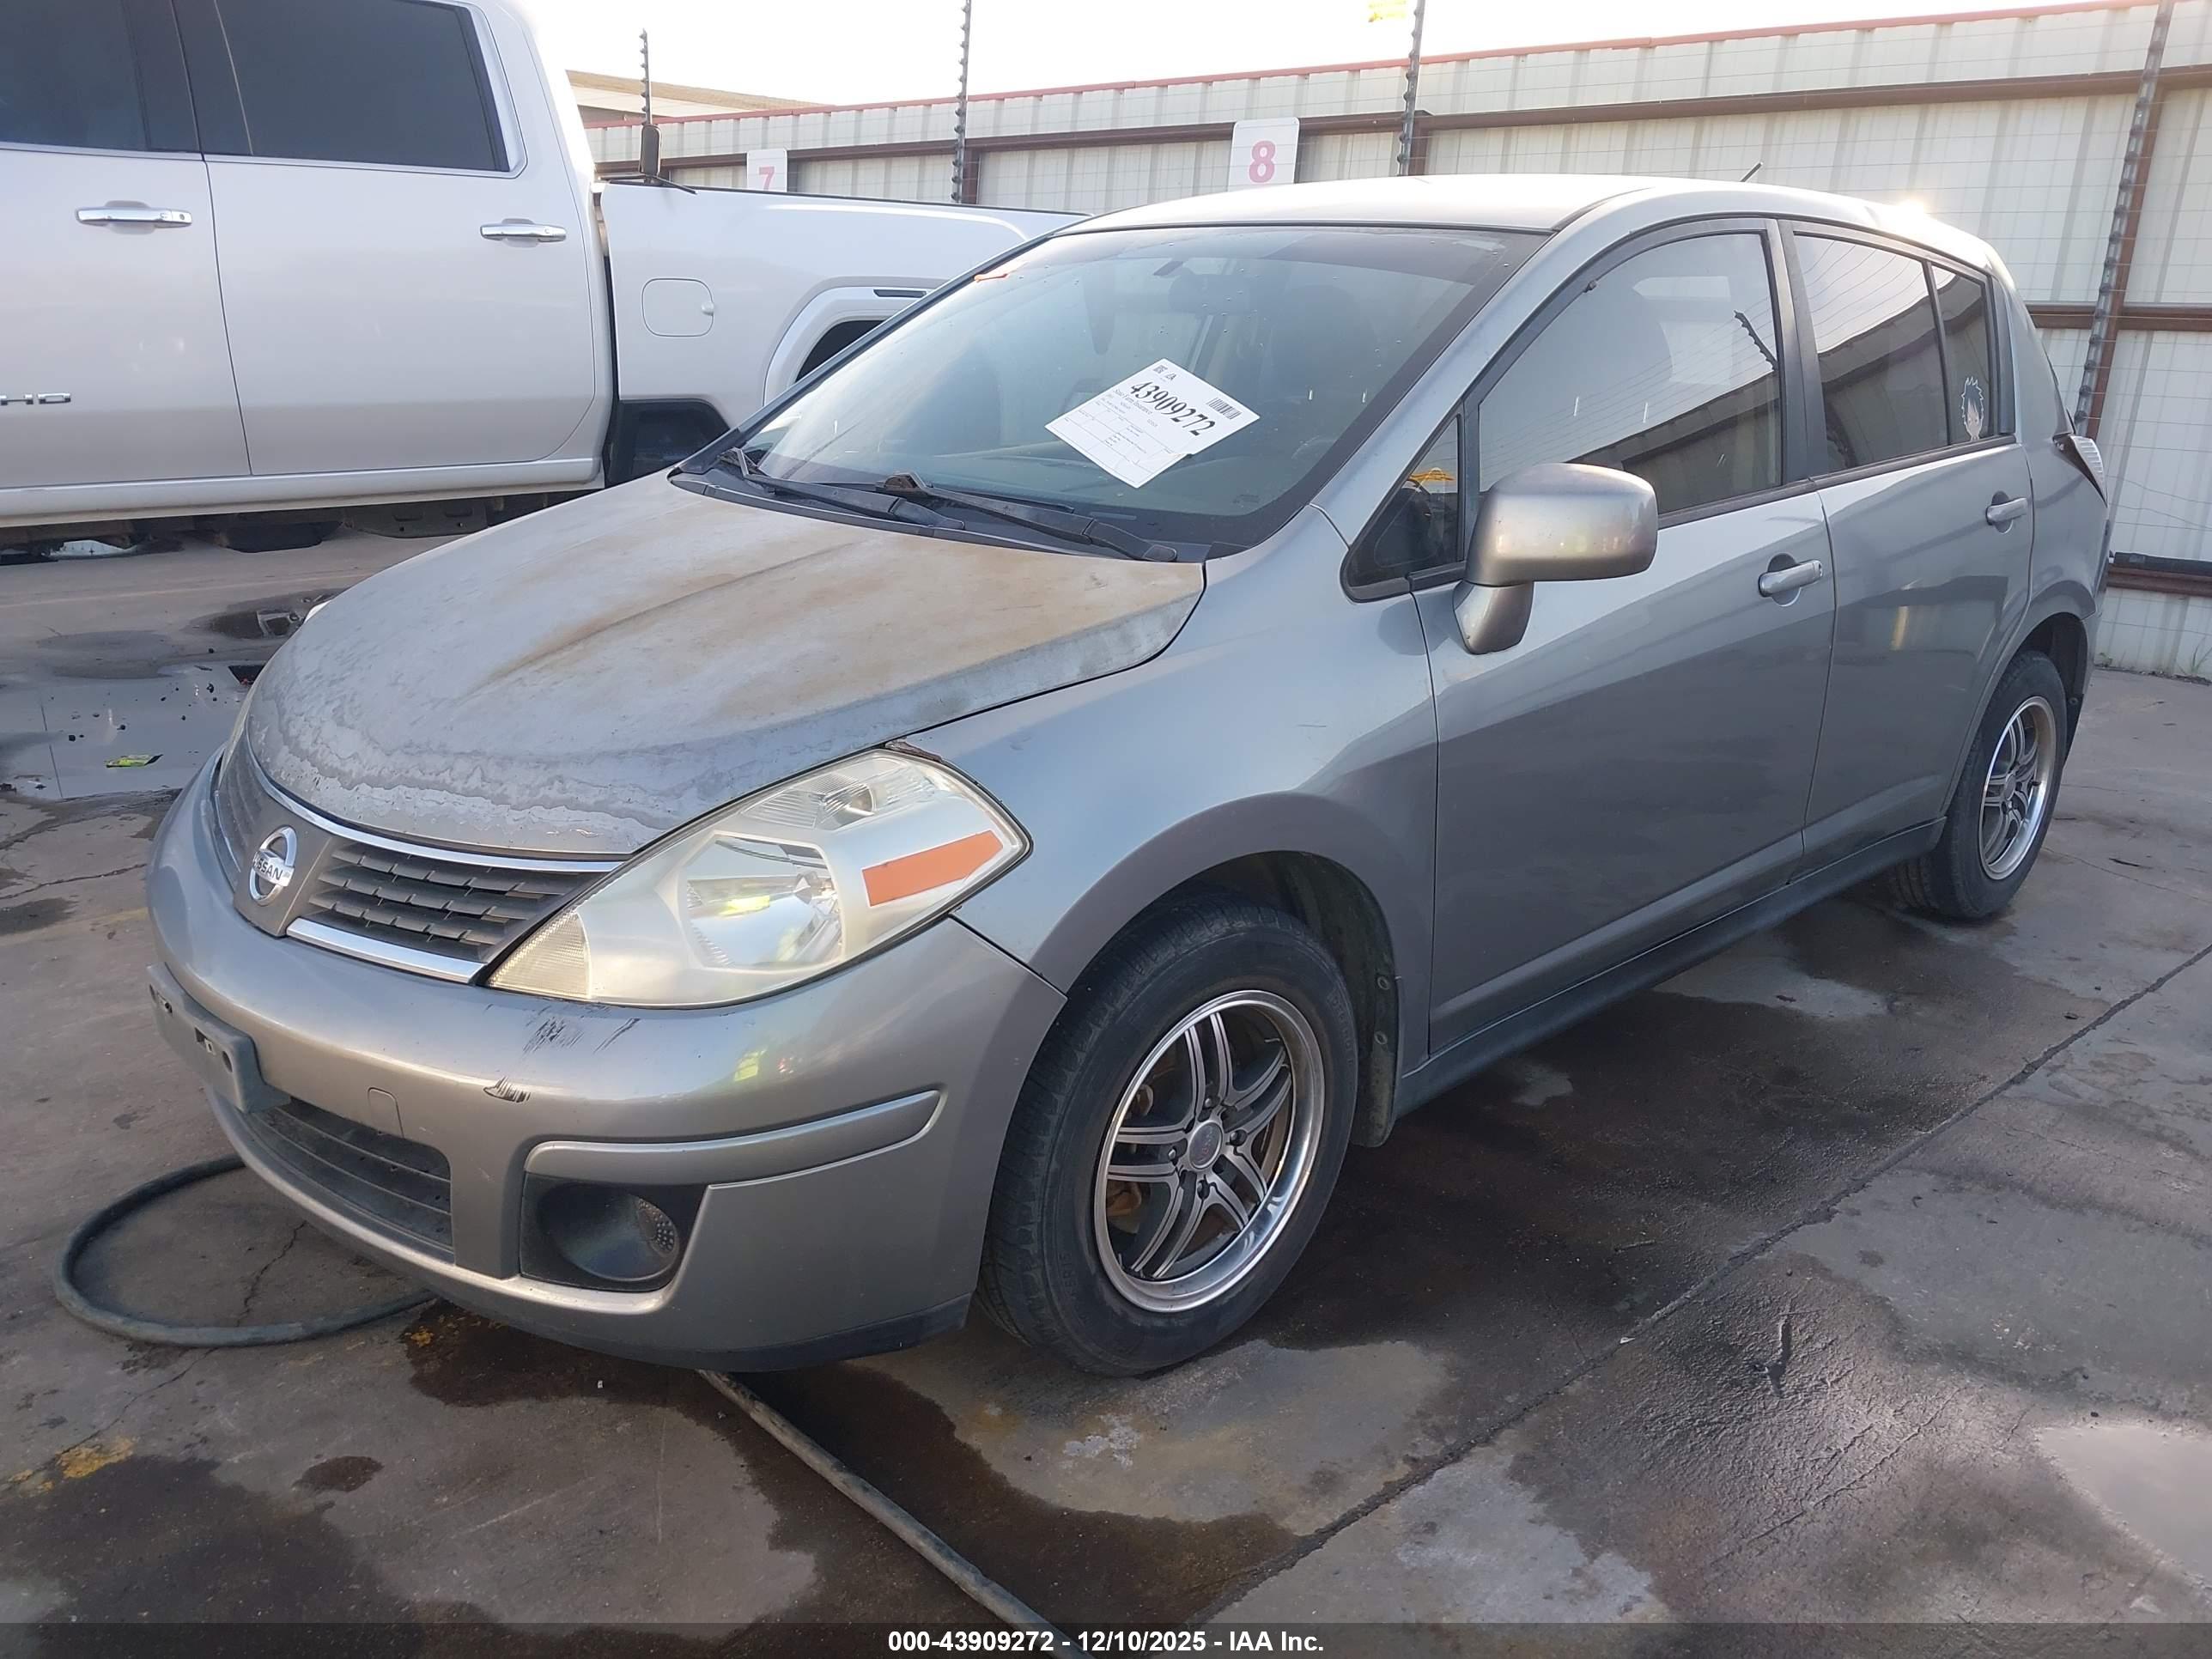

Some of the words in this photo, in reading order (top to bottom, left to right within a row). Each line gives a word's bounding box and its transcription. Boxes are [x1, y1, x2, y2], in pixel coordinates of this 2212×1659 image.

[759, 166, 775, 191] 7
[1249, 141, 1275, 183] 8
[1130, 381, 1215, 436] 43909272
